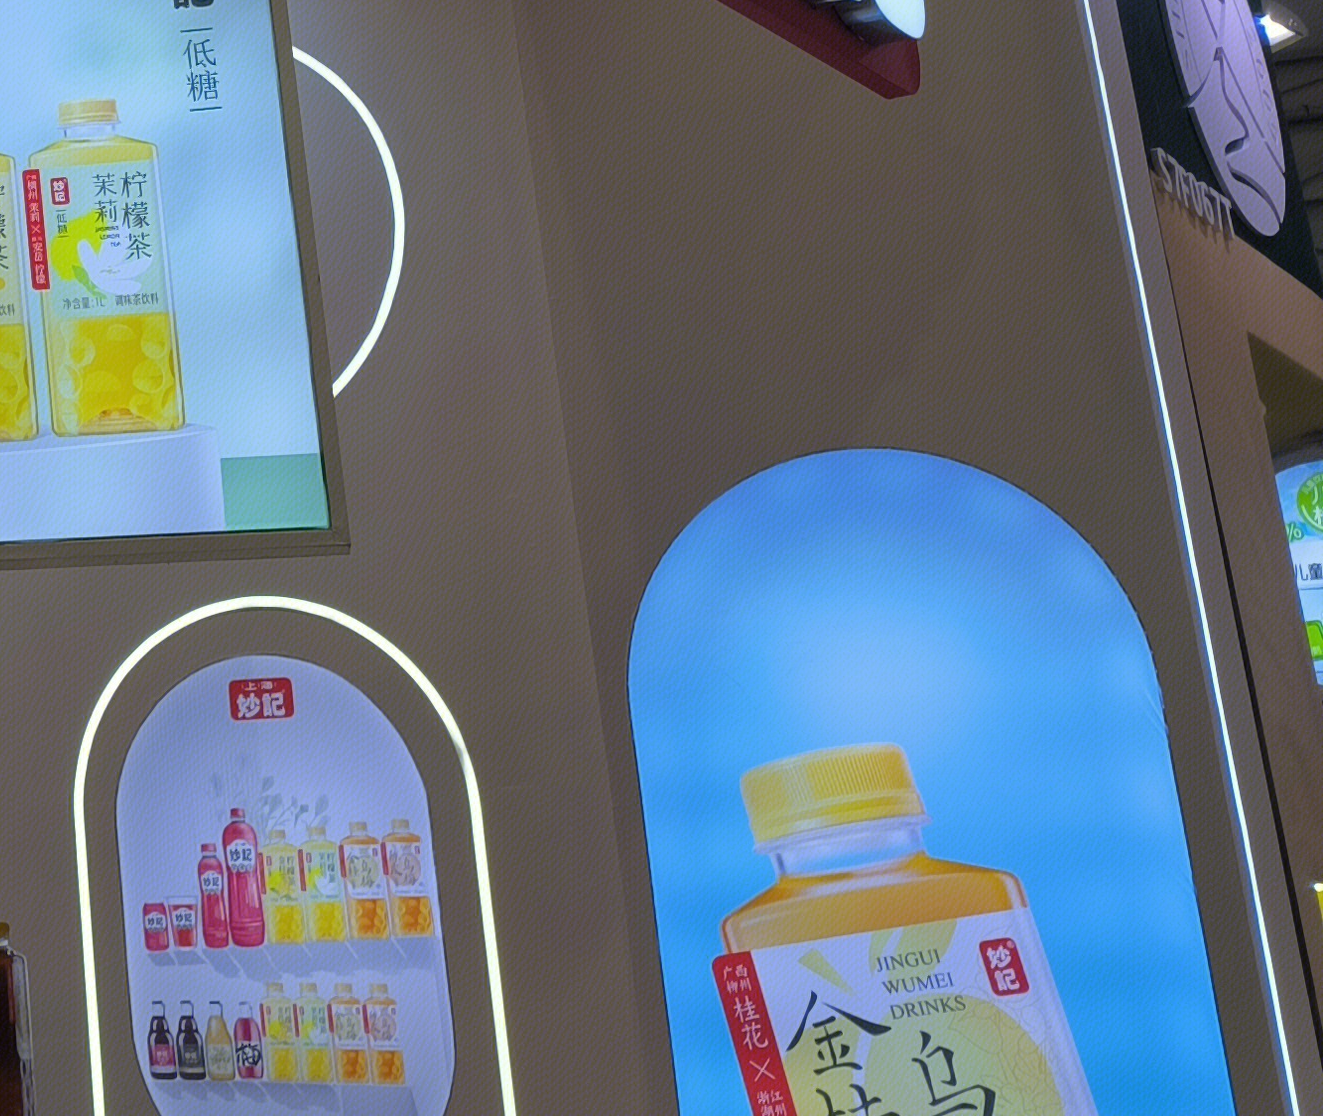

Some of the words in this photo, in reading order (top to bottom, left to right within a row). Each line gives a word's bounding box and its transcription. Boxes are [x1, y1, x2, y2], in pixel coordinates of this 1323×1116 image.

[183, 38, 219, 102] 低糖
[92, 172, 117, 223] 茉莉
[120, 171, 152, 260] 柠檬茶
[237, 692, 286, 718] 妙記
[876, 948, 941, 973] JINGUI
[881, 972, 955, 995] WUMEI
[733, 995, 769, 1051] 桂花
[890, 994, 967, 1020] DRINKS
